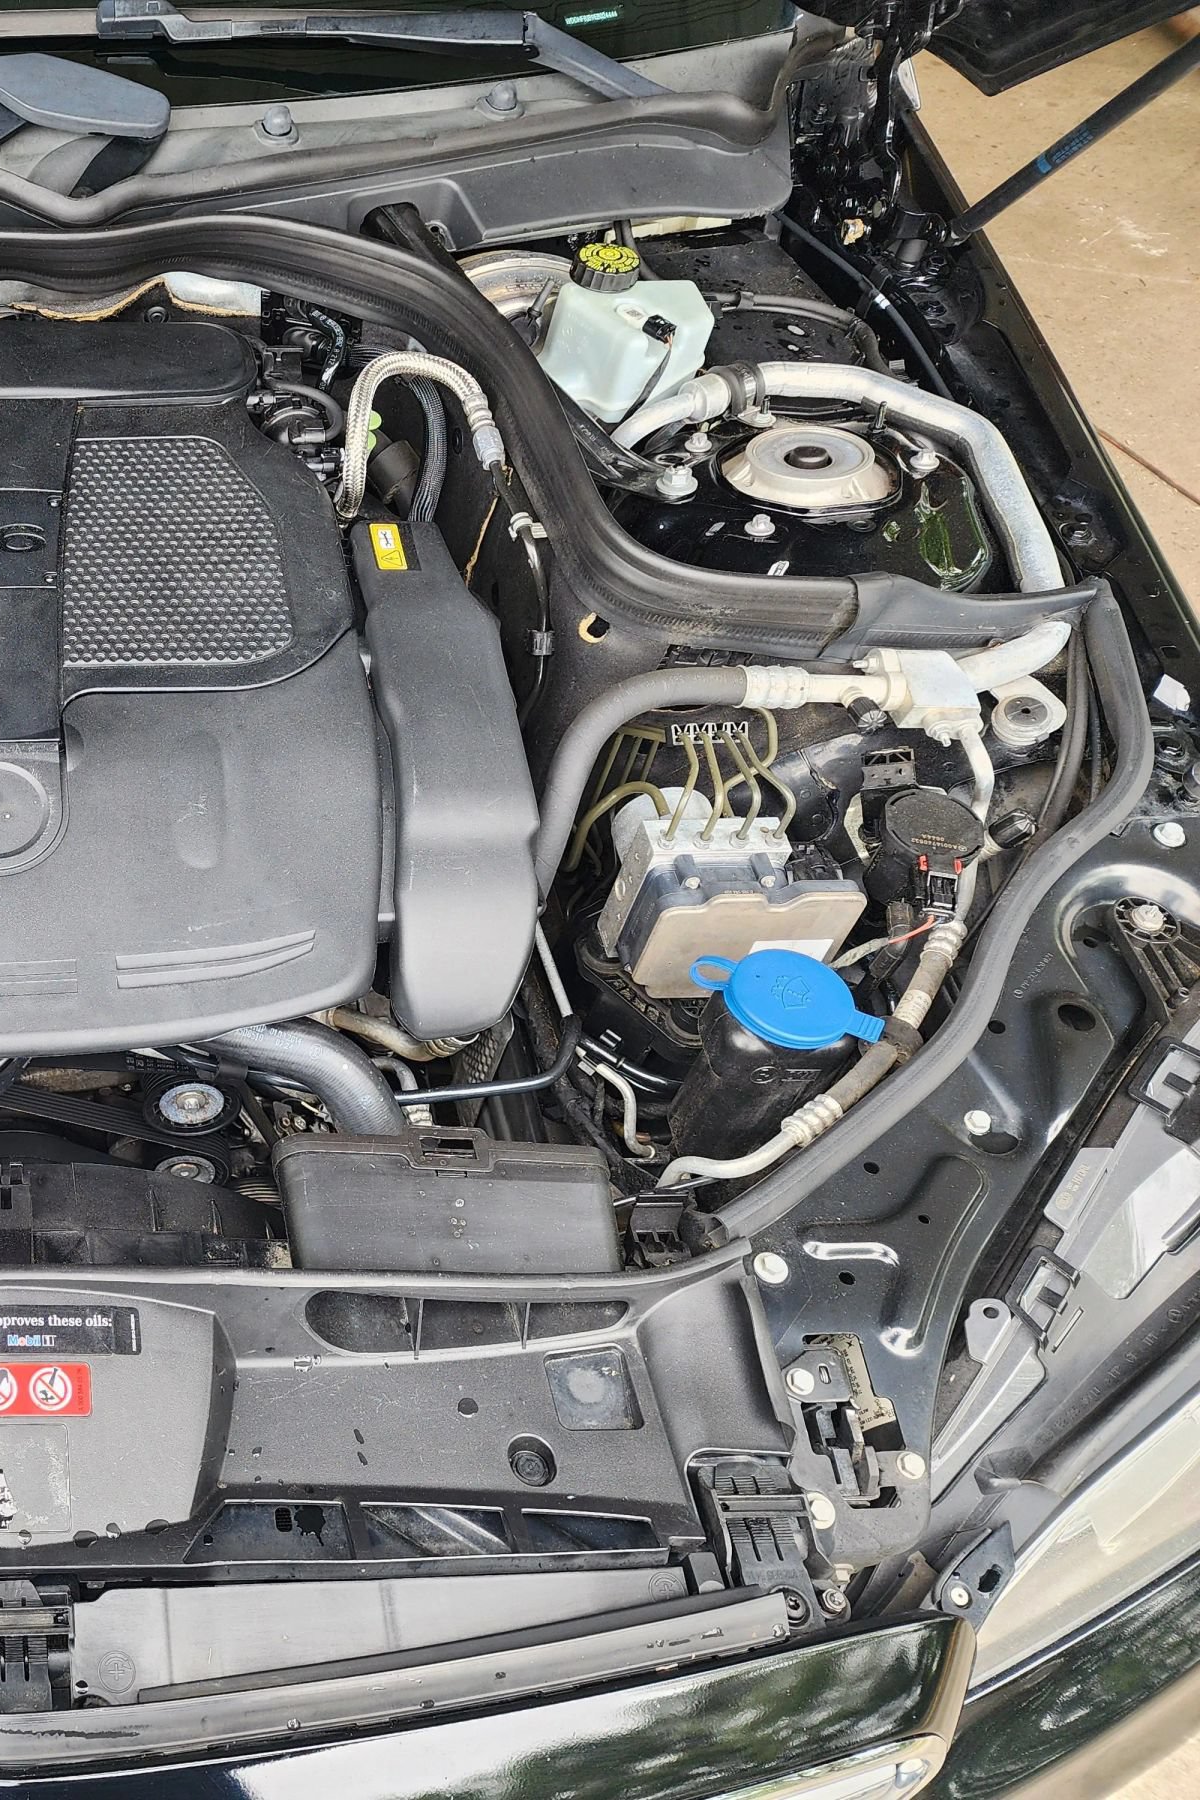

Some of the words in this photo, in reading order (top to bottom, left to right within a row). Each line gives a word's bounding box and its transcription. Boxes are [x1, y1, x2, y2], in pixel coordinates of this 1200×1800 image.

[48, 1314, 83, 1327] these
[85, 1313, 112, 1327] oils:
[7, 1334, 41, 1347] Mobil
